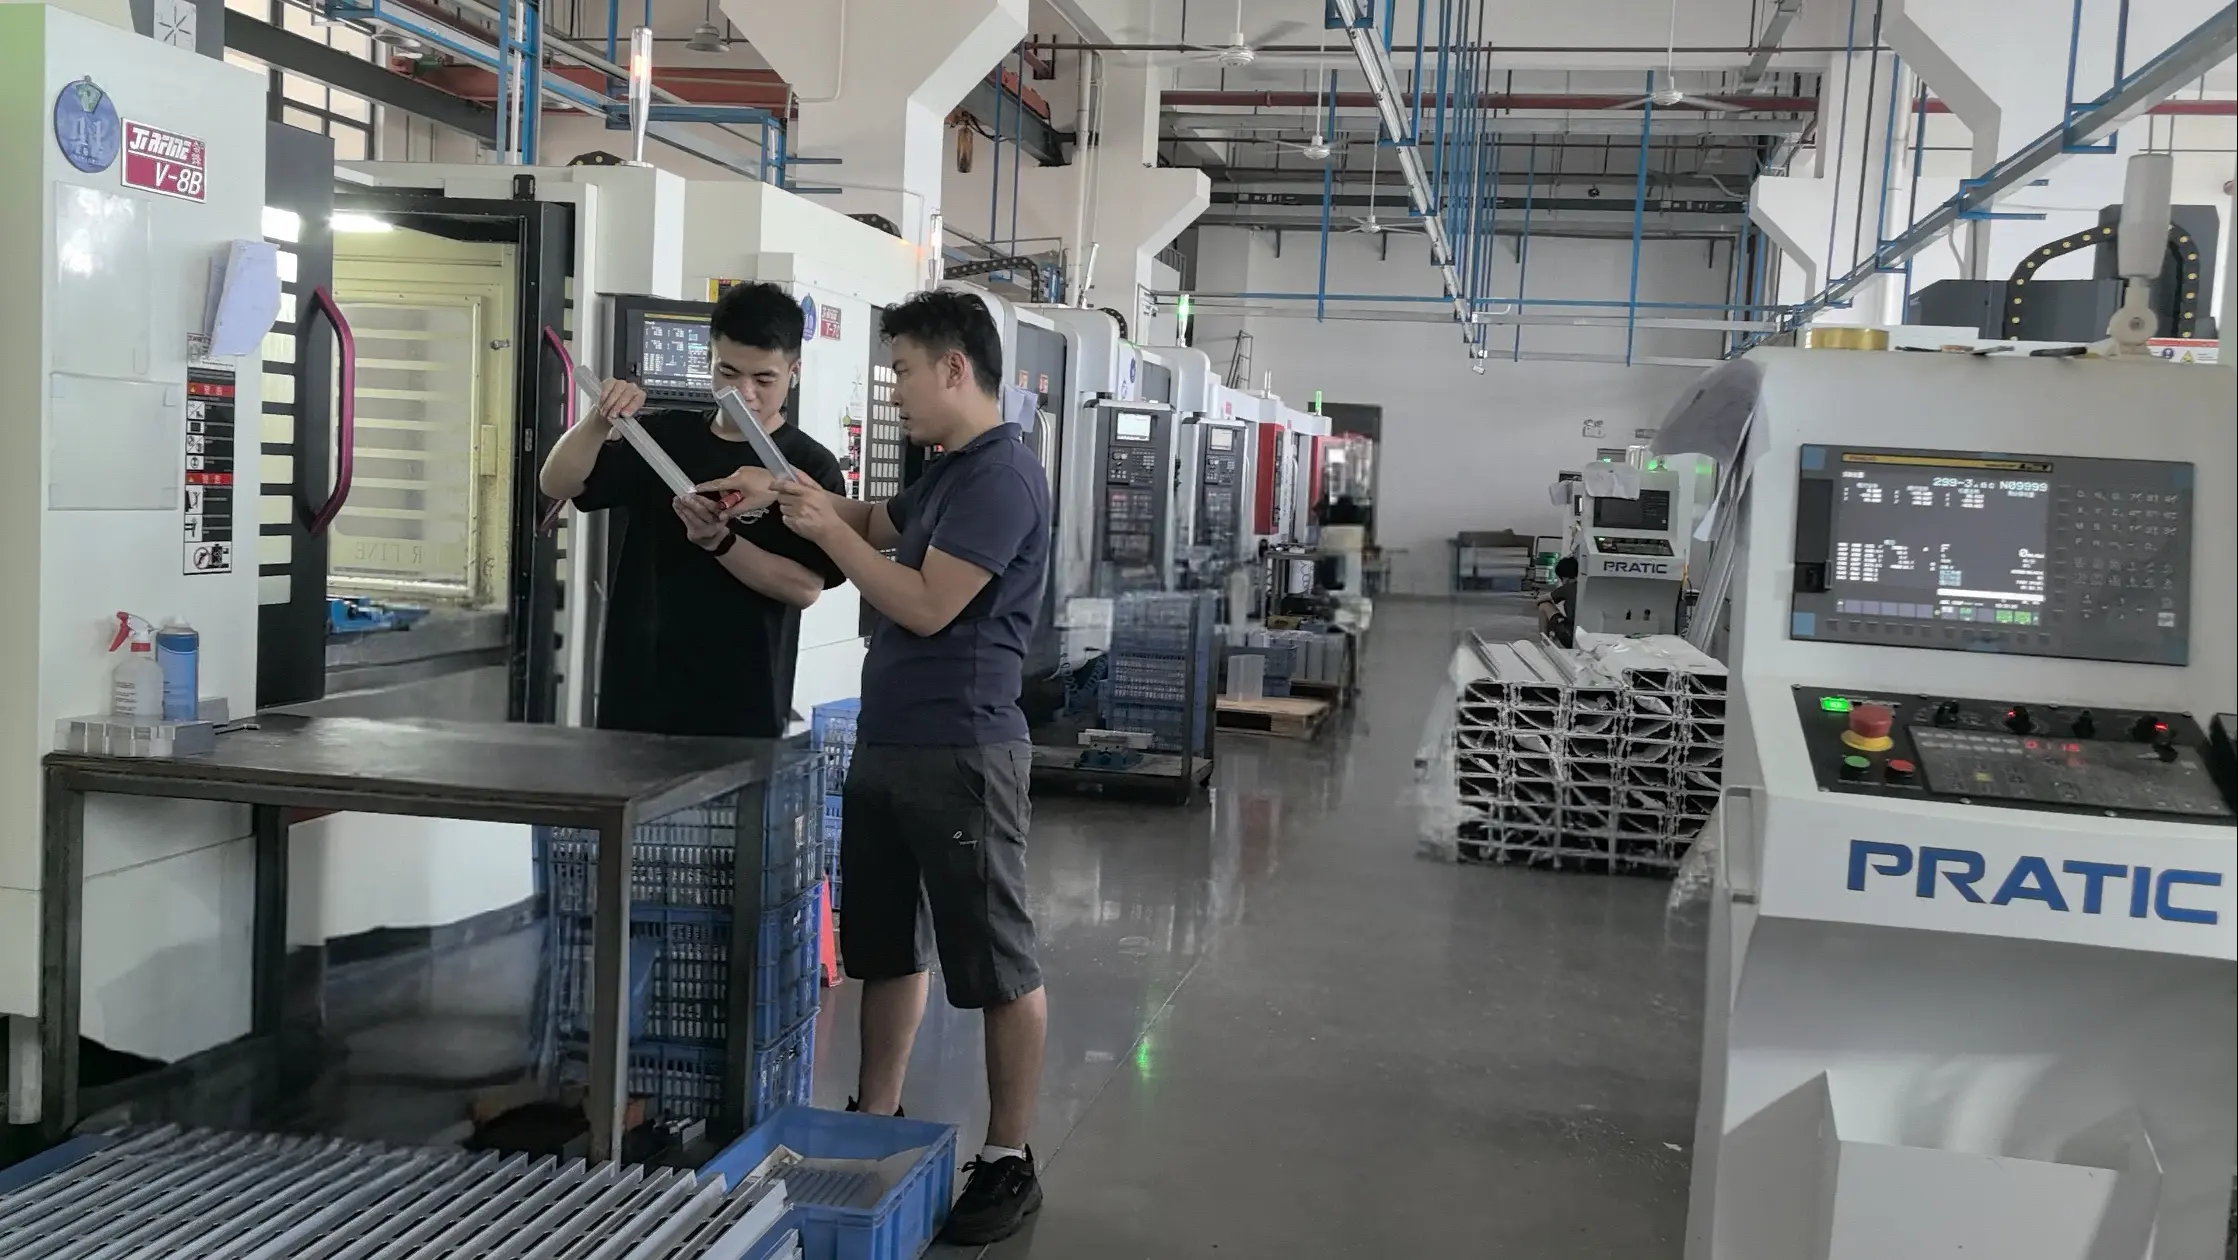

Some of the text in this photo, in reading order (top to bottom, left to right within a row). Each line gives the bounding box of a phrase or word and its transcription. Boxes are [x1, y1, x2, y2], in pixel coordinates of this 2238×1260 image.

[155, 162, 203, 195] V-8B
[2000, 480, 2048, 492] N09999
[1603, 560, 1668, 574] PRATIC
[1846, 839, 2223, 925] PRATIC
